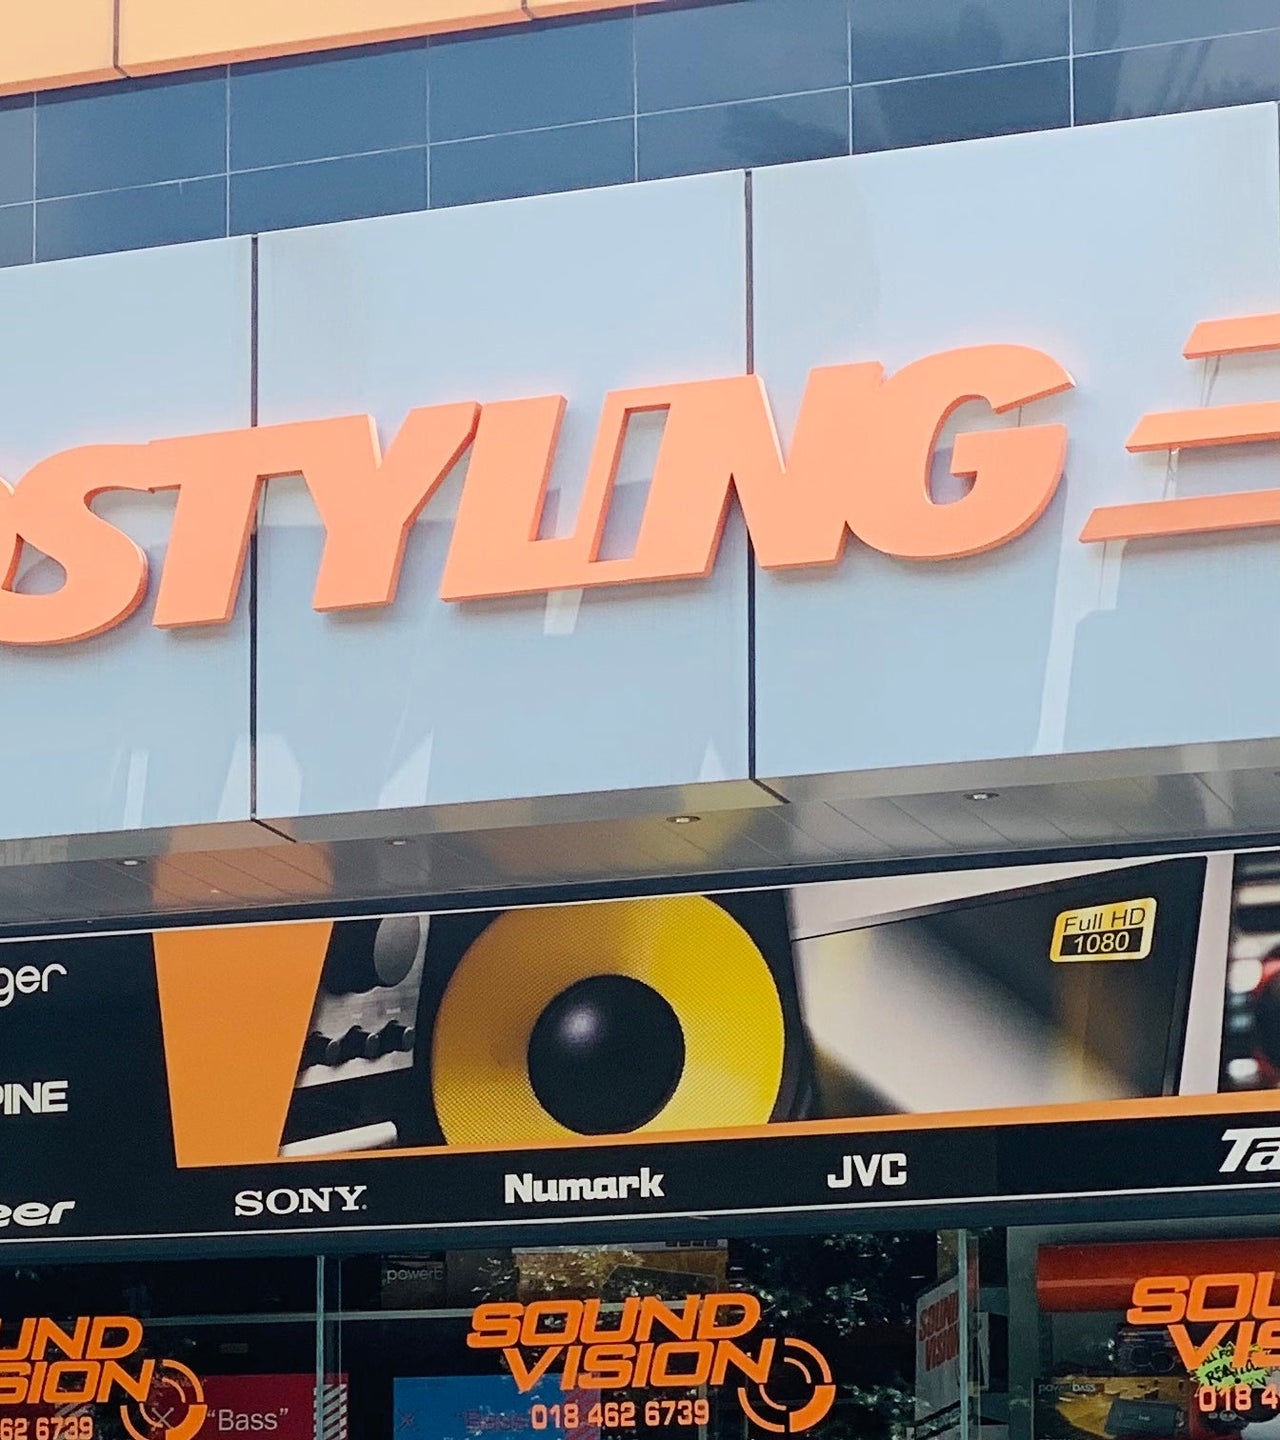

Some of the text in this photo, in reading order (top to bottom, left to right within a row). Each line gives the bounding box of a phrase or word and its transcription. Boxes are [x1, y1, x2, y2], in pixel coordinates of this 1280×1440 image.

[1064, 907, 1146, 933] Full HD
[1074, 931, 1130, 953] 1080
[503, 1167, 665, 1203] Numark
[827, 1152, 907, 1190] JVC
[234, 1185, 367, 1217] SONY
[466, 1292, 761, 1349] SOUND
[502, 1337, 776, 1394] VISION
[1200, 1384, 1252, 1412] 018
[36, 1416, 93, 1440] 6739
[531, 1399, 710, 1430] 018 462 6739
